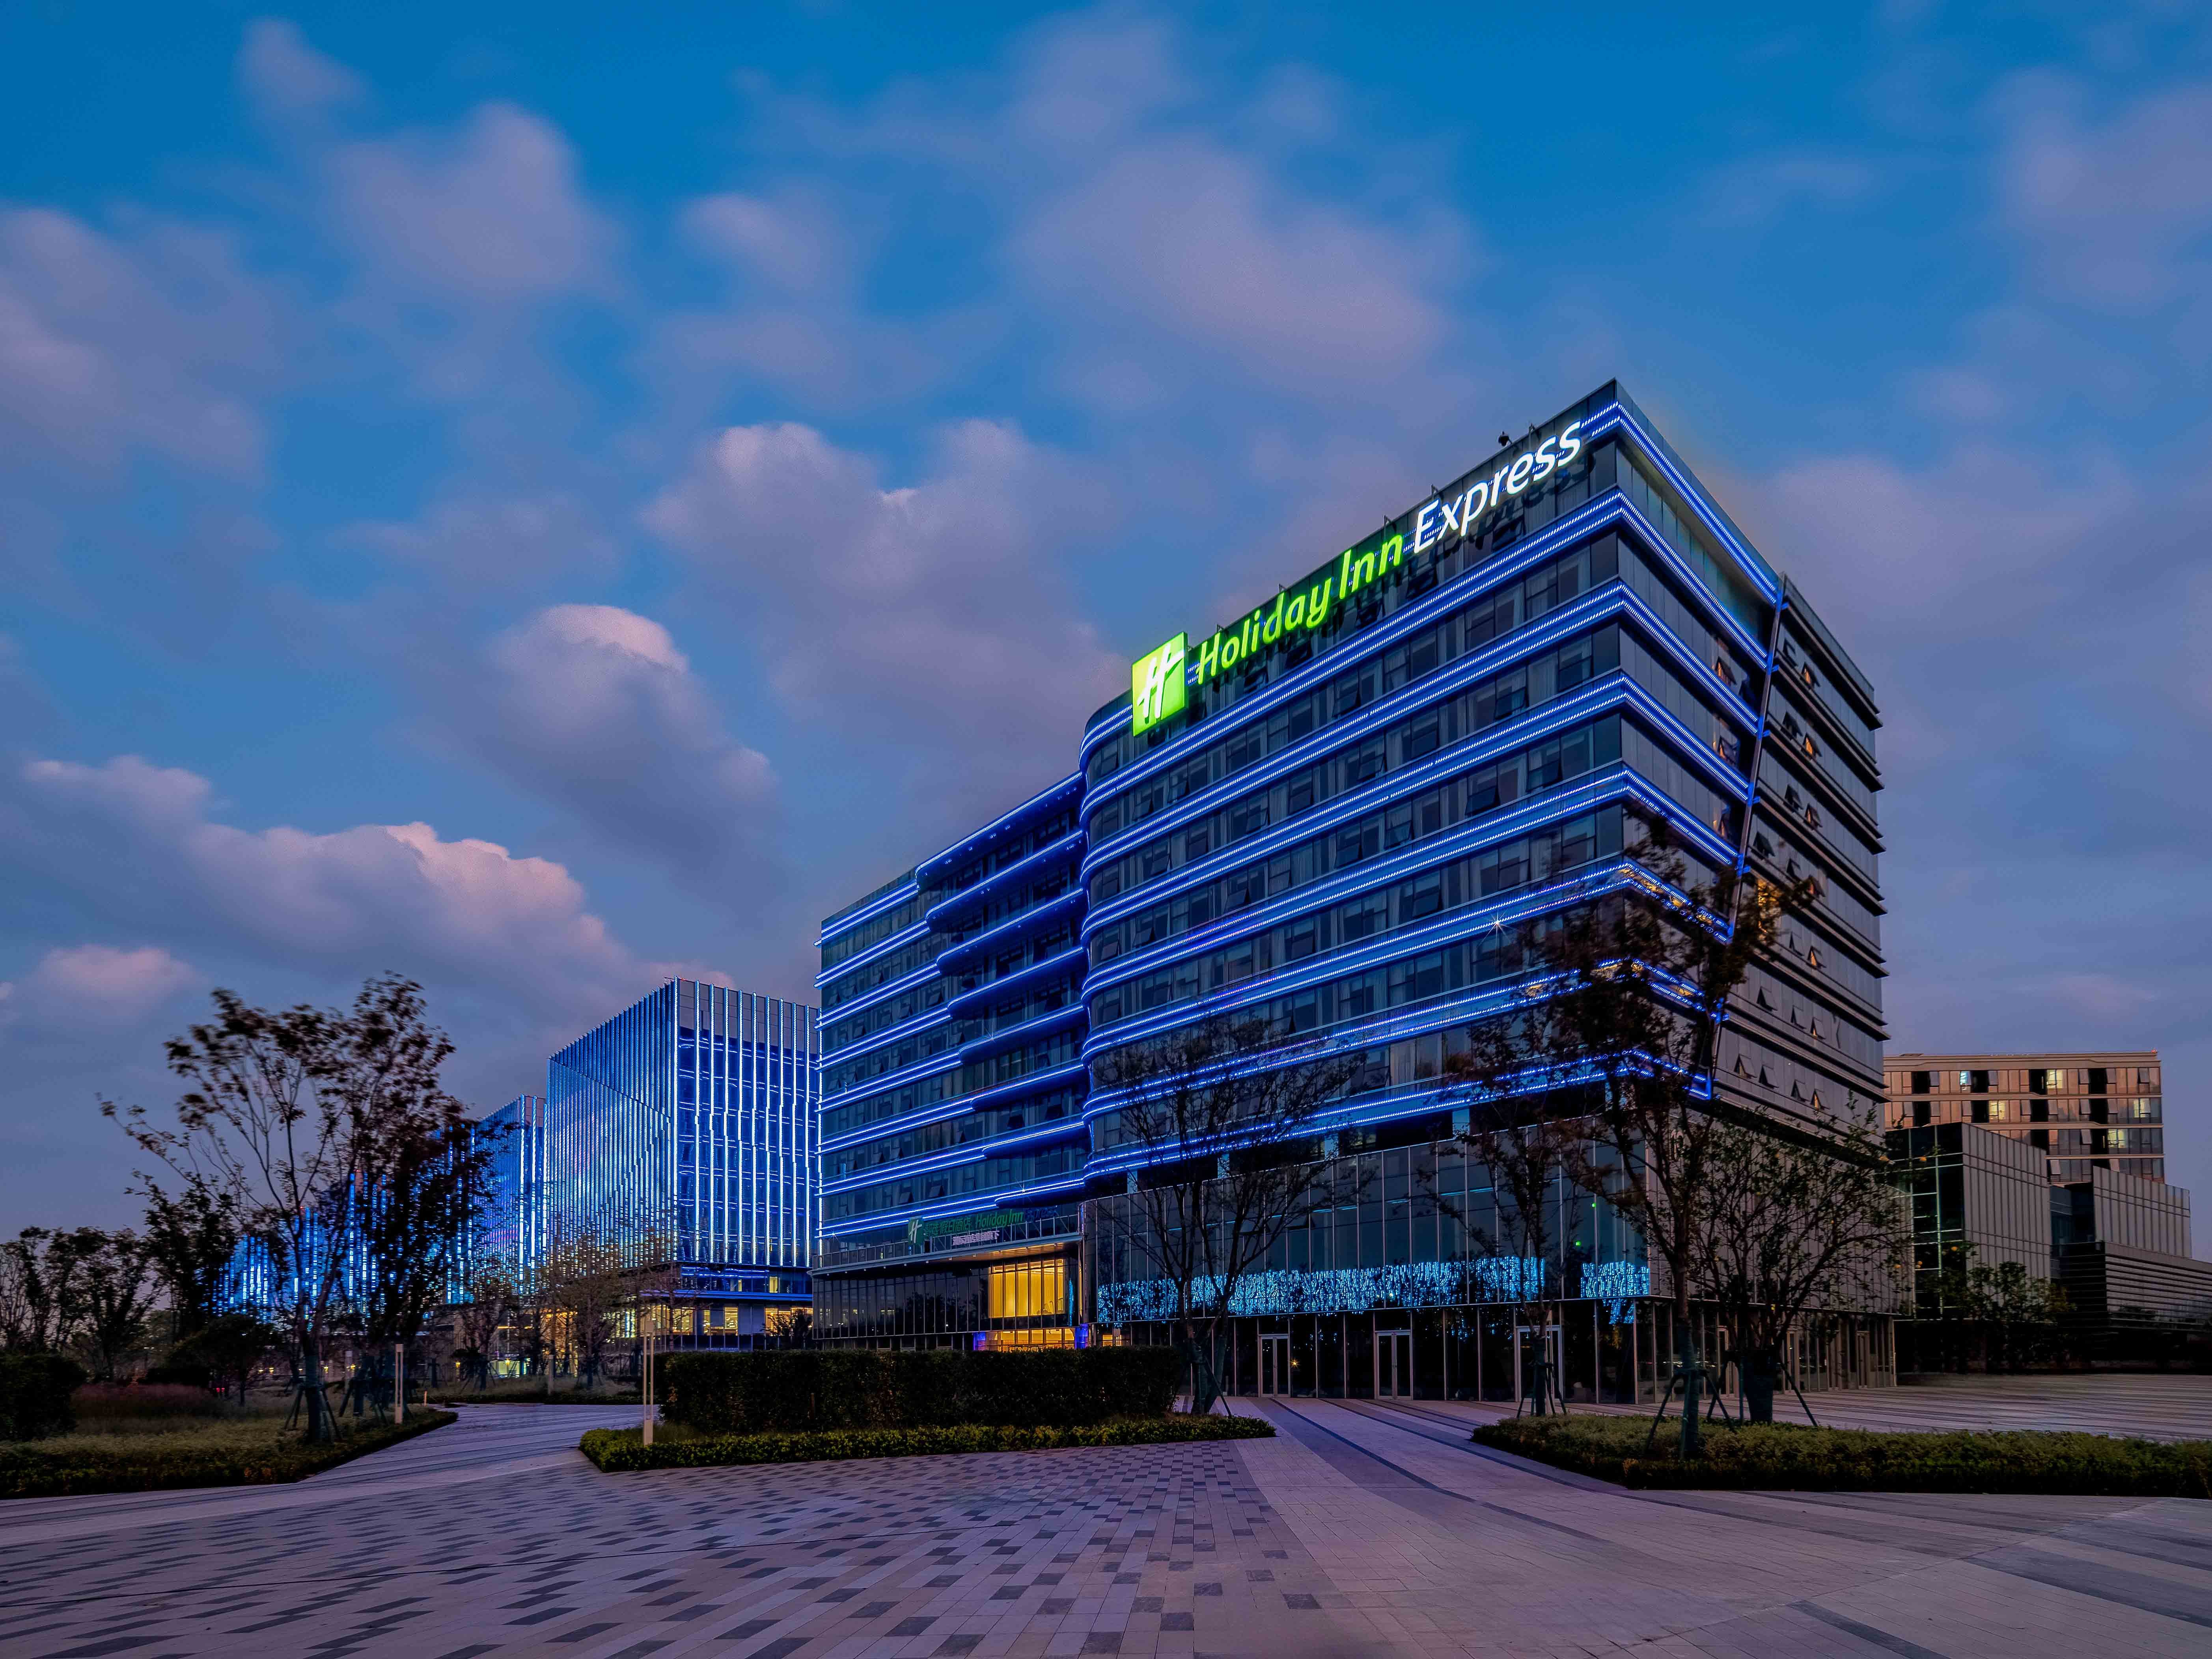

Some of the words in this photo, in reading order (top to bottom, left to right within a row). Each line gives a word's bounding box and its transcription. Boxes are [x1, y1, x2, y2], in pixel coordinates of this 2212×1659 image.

[1196, 577, 1332, 684] Holiday
[1339, 535, 1403, 599] Inn
[1414, 420, 1581, 554] Express
[975, 1212, 1009, 1228] Holiday
[1009, 1209, 1024, 1224] Inn
